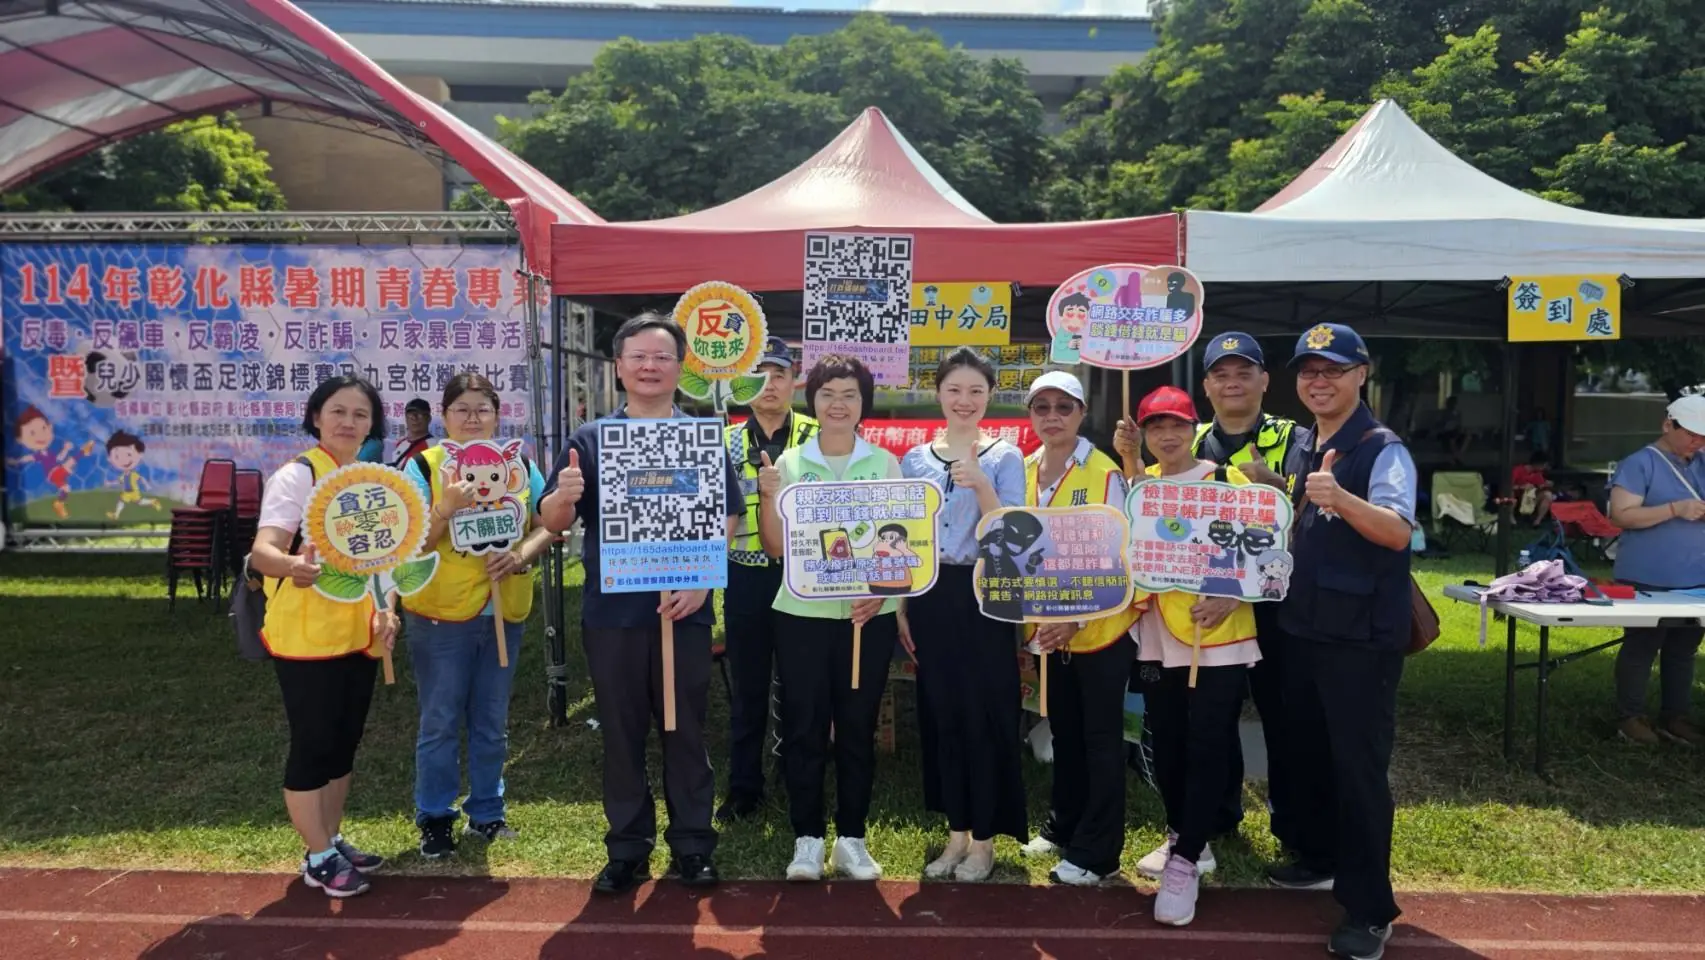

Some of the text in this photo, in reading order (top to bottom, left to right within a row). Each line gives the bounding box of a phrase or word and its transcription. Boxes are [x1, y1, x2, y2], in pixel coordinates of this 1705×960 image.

[910, 304, 1009, 330] 田中分局
[1090, 303, 1187, 323] 網路交友詐騙多
[1513, 282, 1613, 336] 簽到處
[693, 337, 745, 359] 你我來
[48, 354, 86, 398] 暨
[336, 486, 387, 515] 貪污
[796, 485, 926, 505] 親友來電換電話
[1142, 484, 1277, 506] 檢警要錢必詐騙
[355, 511, 380, 532] 零
[796, 503, 927, 524] 講到匯錢就是騙
[1142, 501, 1276, 524] 監管帳戶都是騙
[456, 514, 516, 541] 不關說
[348, 528, 396, 555] 容忍
[601, 543, 726, 557] https://165dashboard.tw/
